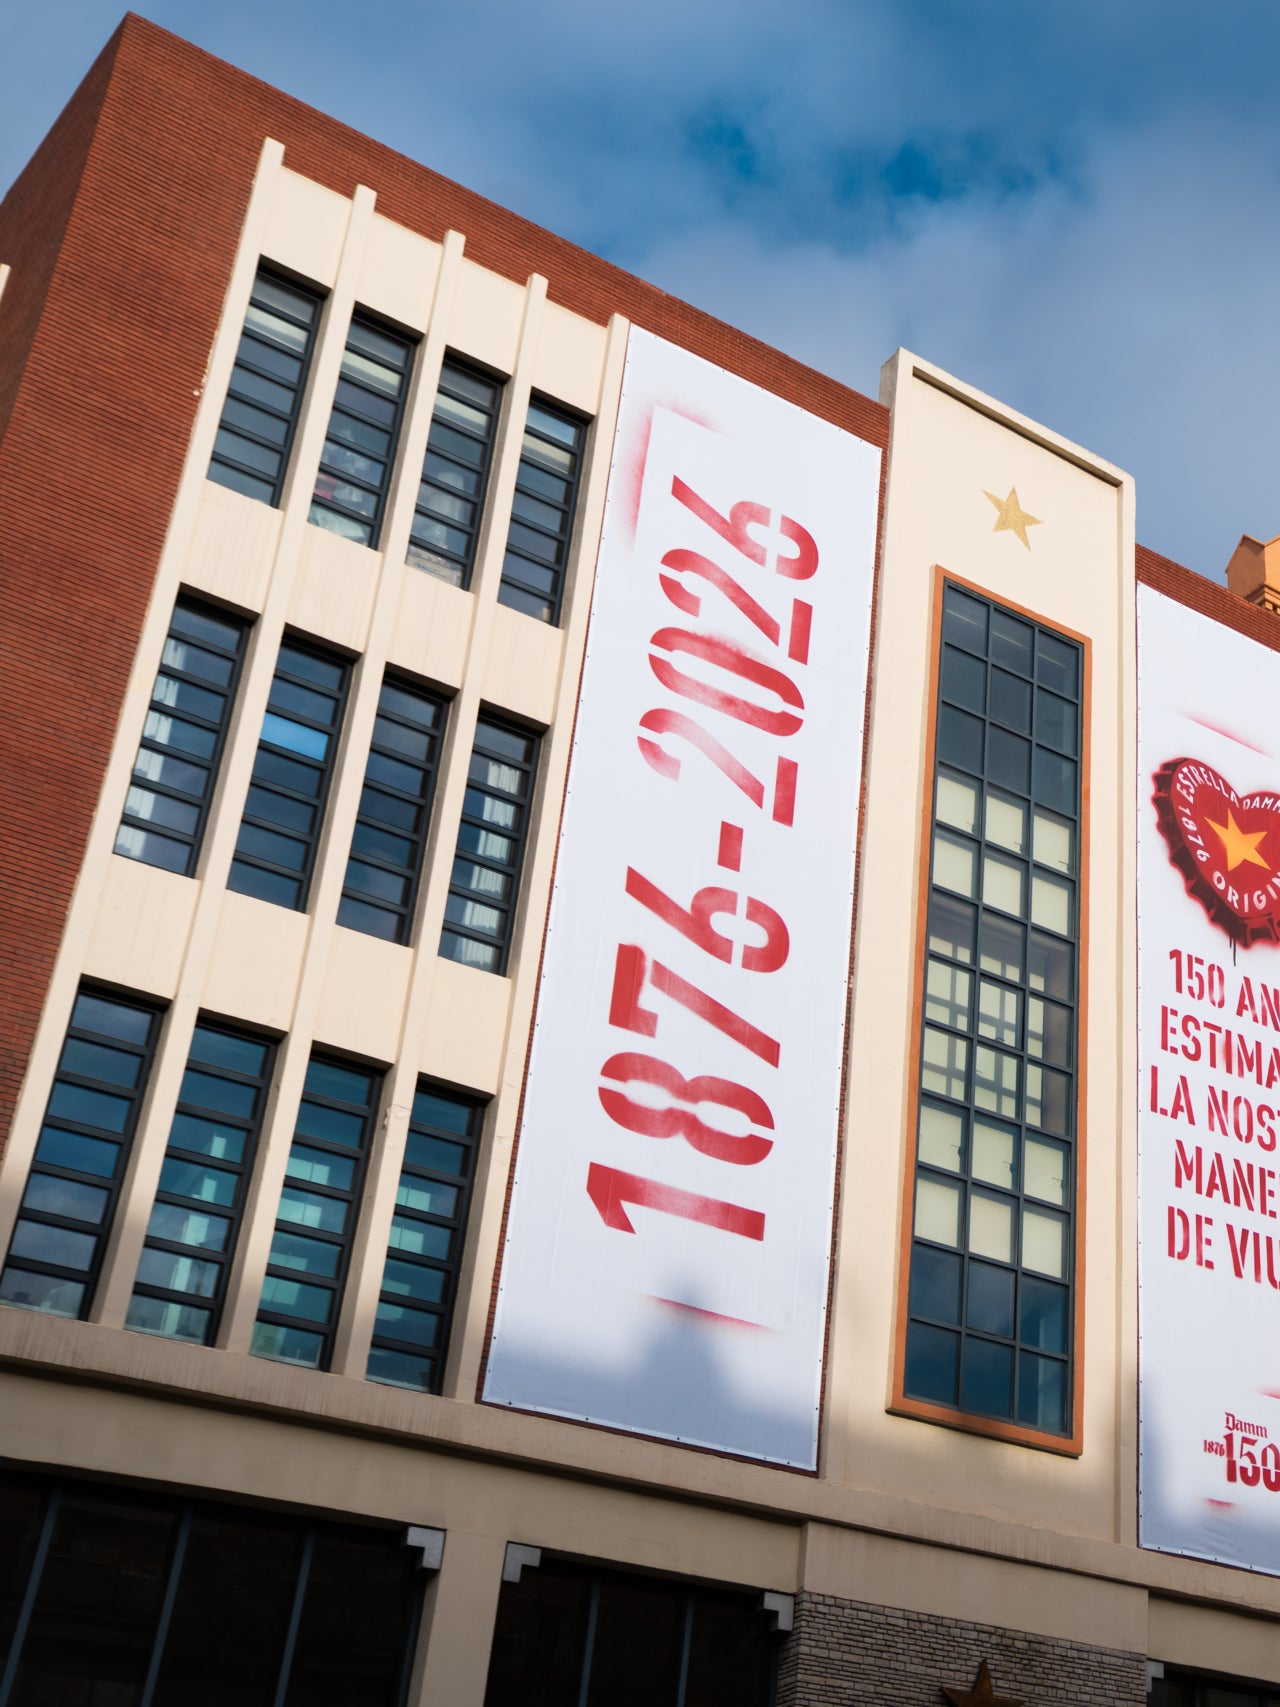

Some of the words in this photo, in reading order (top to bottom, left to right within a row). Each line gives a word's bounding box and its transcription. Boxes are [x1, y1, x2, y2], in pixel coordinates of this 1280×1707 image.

[1176, 765, 1239, 808] ESTRELLA
[587, 474, 819, 1241] 1876-2026
[1178, 806, 1210, 862] 1876
[1169, 948, 1225, 1009] 150
[1150, 1065, 1196, 1126] LA
[1167, 1205, 1214, 1270] DE
[1203, 1440, 1225, 1456] 1876
[1224, 1411, 1268, 1438] Damm
